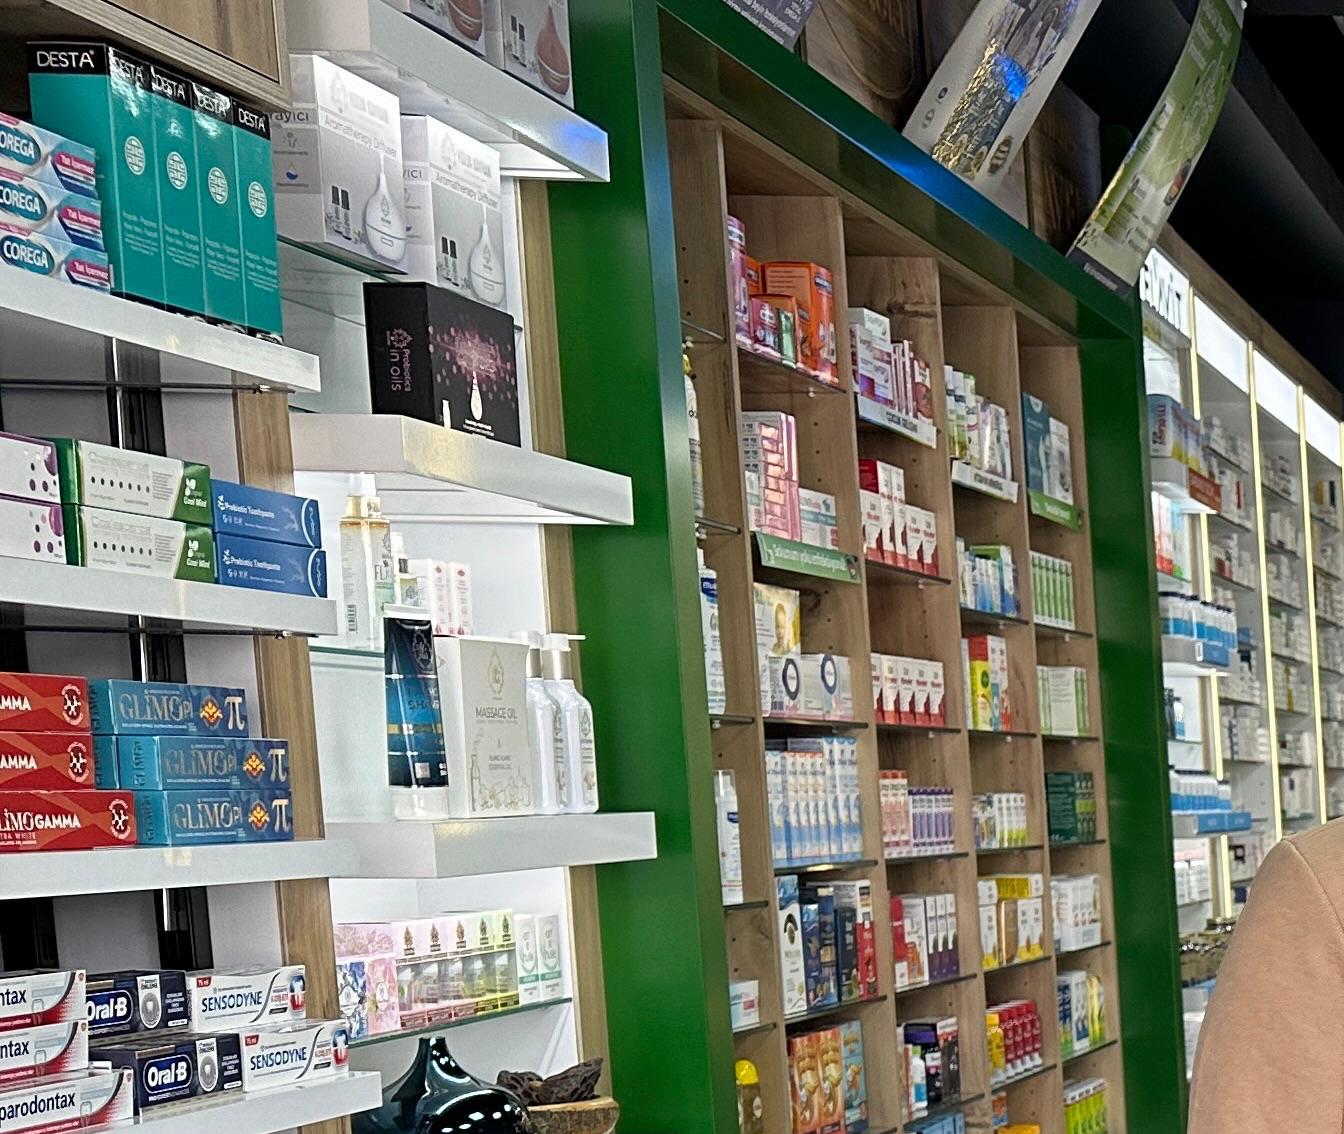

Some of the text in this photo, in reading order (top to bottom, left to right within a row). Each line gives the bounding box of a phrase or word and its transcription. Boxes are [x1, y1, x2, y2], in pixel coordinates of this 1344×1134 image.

[37, 50, 95, 68] DESTA
[238, 107, 266, 132] DESTA
[0, 129, 35, 160] OREGA
[3, 240, 49, 269] COREGA
[86, 996, 127, 1022] Oral-B
[201, 991, 262, 1013] SENSODYNE
[0, 1040, 30, 1060] ntax
[249, 1047, 307, 1071] SENSODYNE
[147, 1062, 187, 1087] Oral-B
[0, 1092, 76, 1128] parodontax
